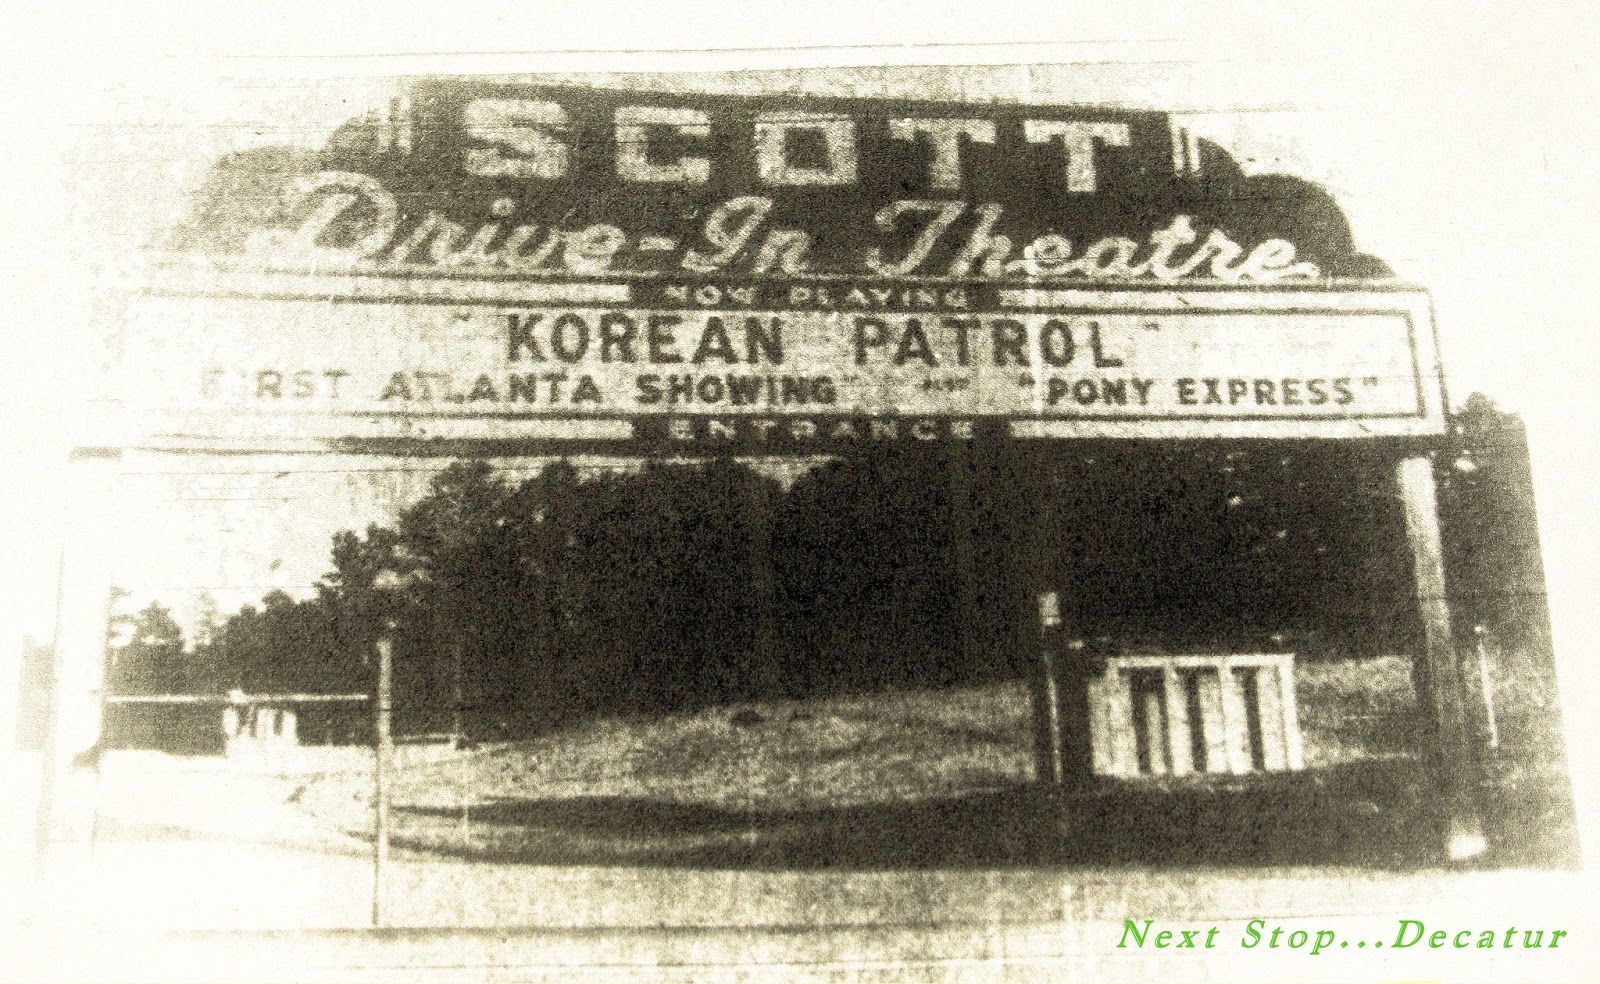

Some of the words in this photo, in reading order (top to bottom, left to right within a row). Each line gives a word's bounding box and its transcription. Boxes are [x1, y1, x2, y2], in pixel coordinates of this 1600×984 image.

[463, 98, 1131, 194] SCOTT
[245, 170, 809, 278] Drive-In
[867, 200, 1321, 283] Theatre
[790, 285, 968, 308] PLAYING
[506, 311, 783, 366] KOREAN
[853, 316, 1124, 368] PATROL
[202, 368, 350, 400] FRST
[380, 371, 600, 405] ATLANTA
[635, 374, 837, 406] SHOWING
[670, 418, 976, 442] ENTRANCE
